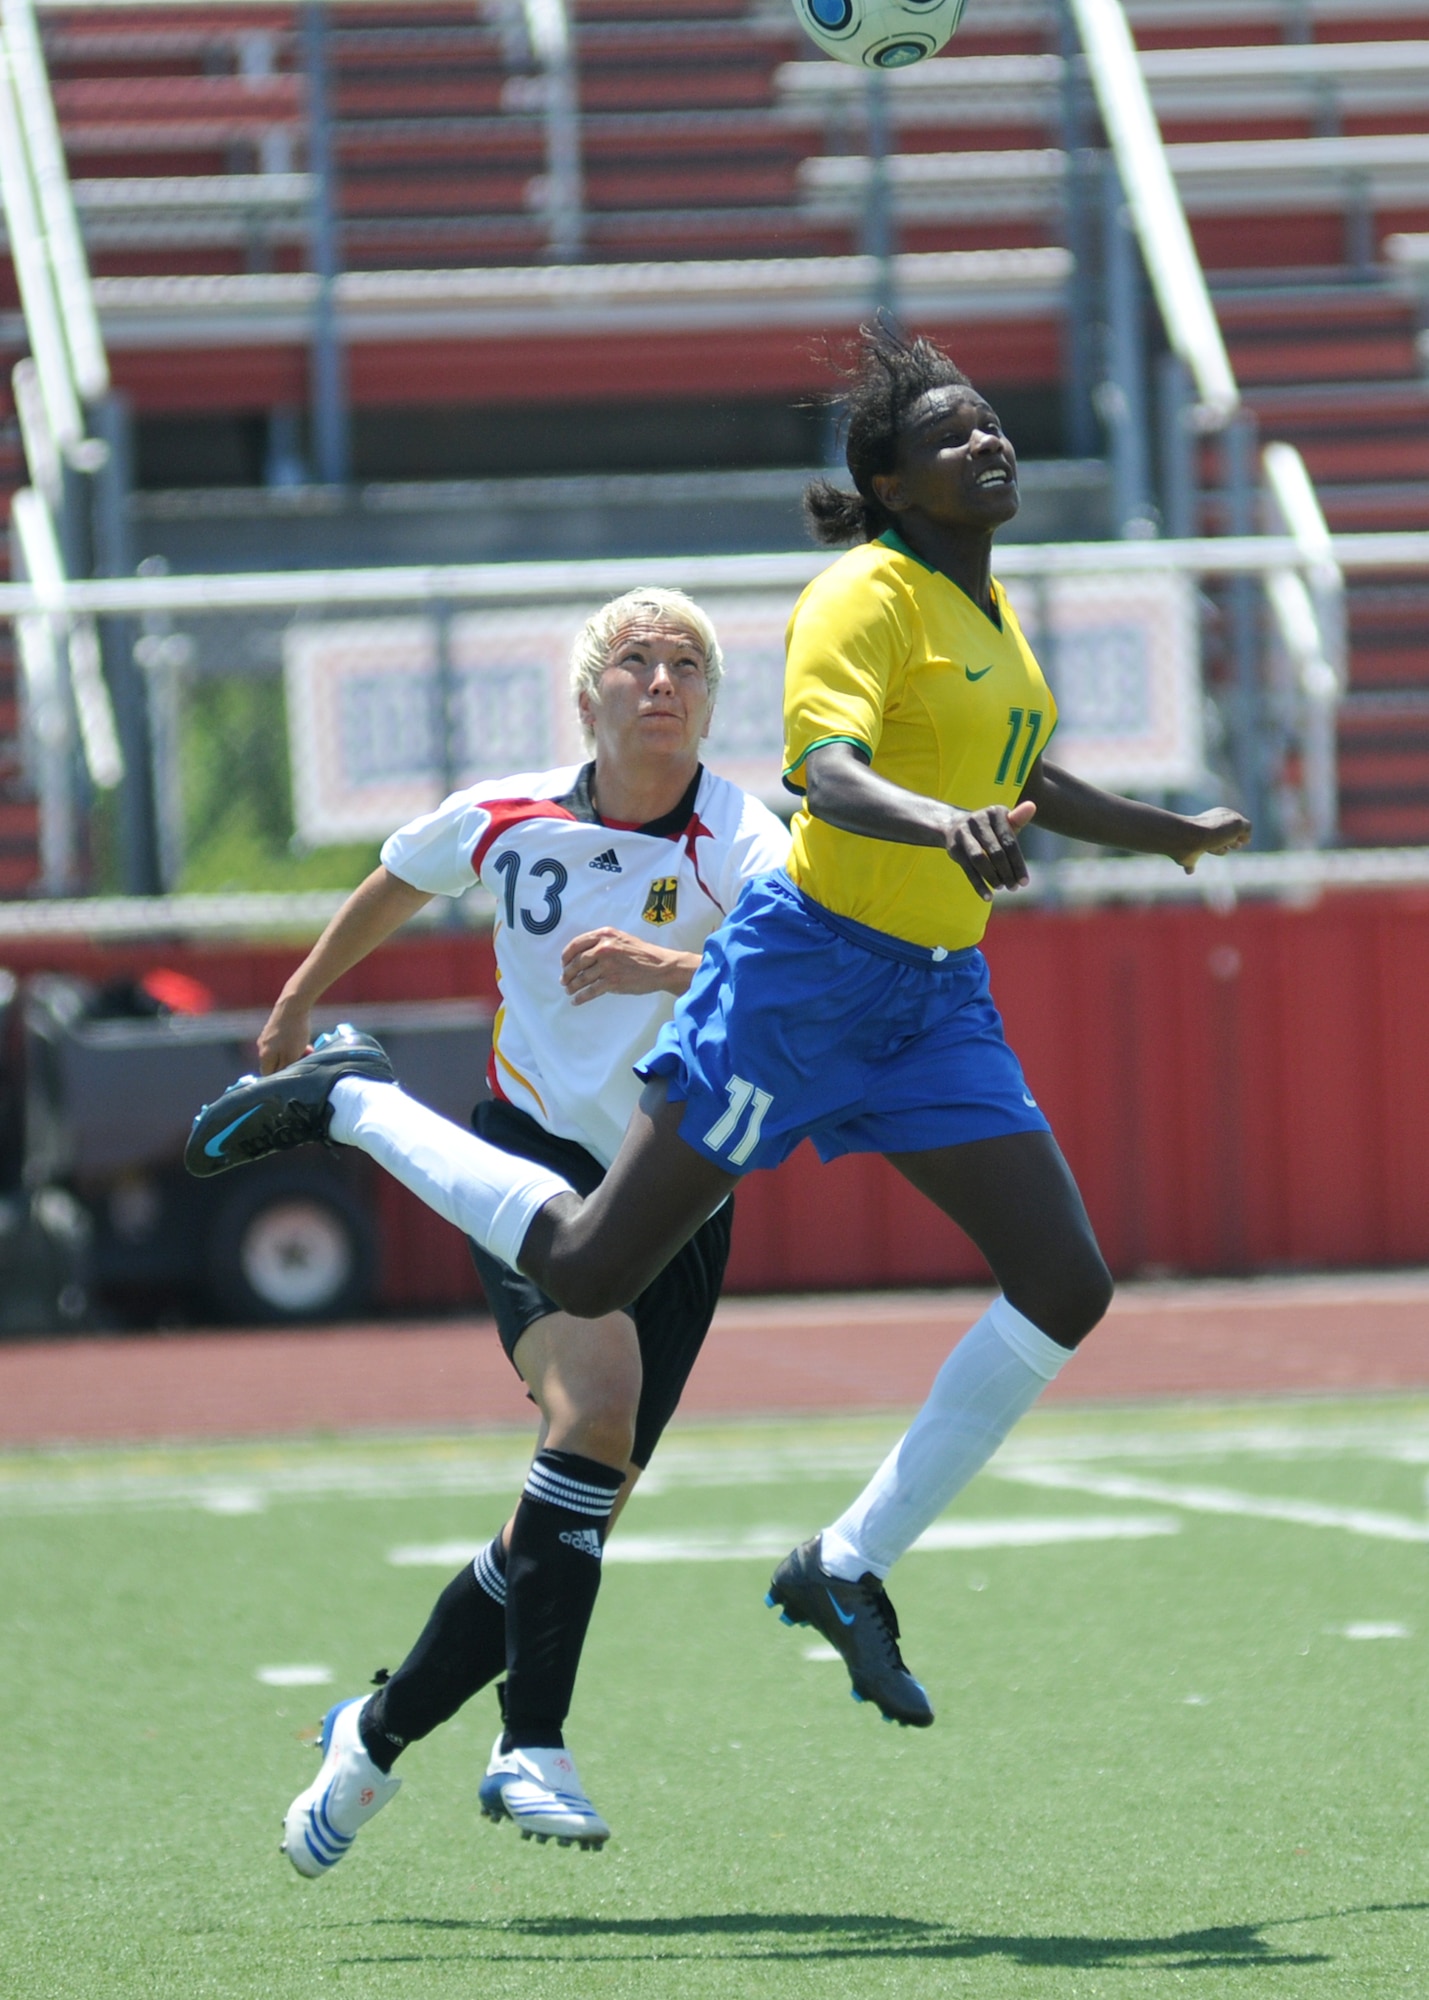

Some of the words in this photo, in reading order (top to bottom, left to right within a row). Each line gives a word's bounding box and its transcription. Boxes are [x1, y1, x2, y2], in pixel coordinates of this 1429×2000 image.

[994, 707, 1043, 787] 11
[494, 850, 568, 935] 13
[588, 861, 622, 873] adidas
[702, 1073, 775, 1166] 11
